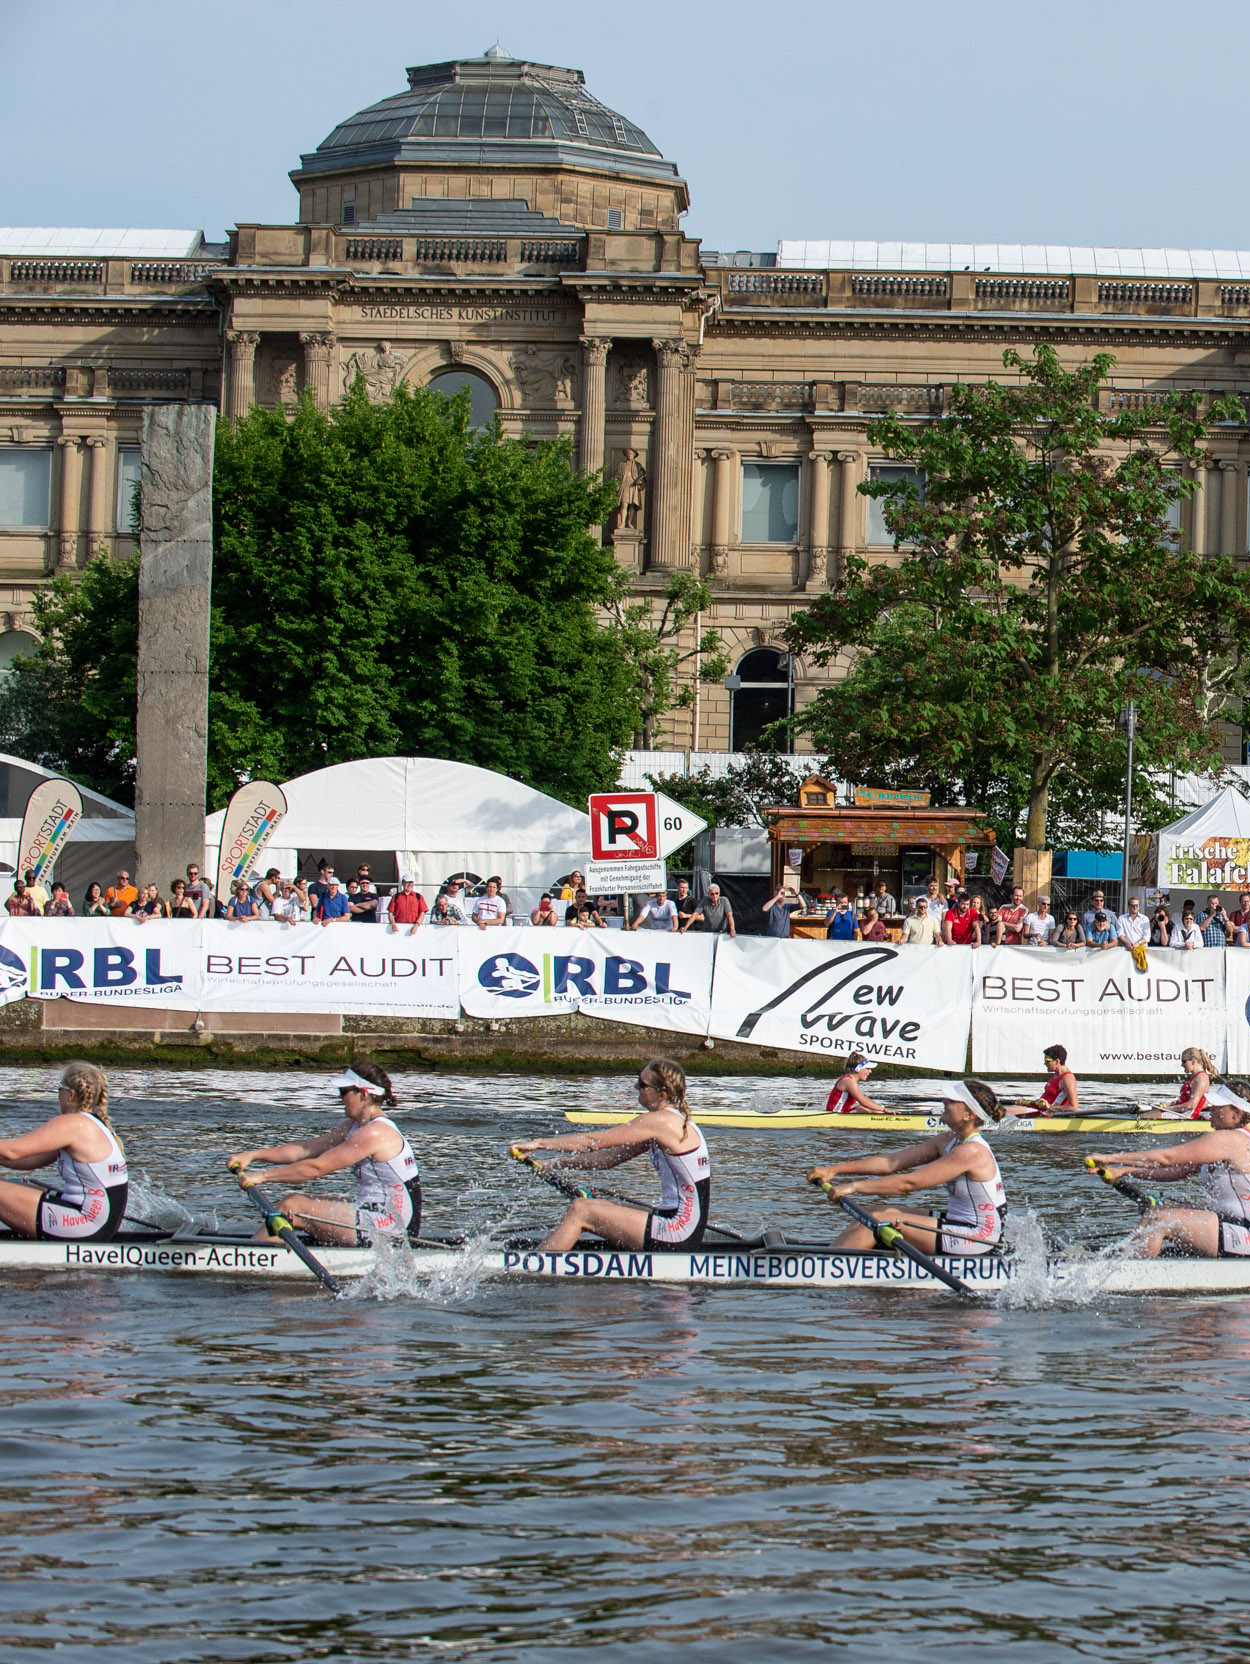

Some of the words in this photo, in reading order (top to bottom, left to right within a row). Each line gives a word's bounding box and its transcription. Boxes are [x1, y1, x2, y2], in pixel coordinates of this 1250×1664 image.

[361, 306, 453, 320] STAEDELSCHES
[21, 799, 69, 873] SPORTSTADT
[221, 799, 272, 875] SPORTSTADT
[663, 817, 682, 831] 60
[37, 838, 63, 883] FRANKFURT
[1170, 841, 1238, 860] frische
[589, 866, 623, 875] Ausgenommen
[624, 864, 661, 873] Fahrgastschiffe
[609, 874, 642, 882] Genehmigung
[41, 946, 183, 990] RBL
[207, 955, 315, 976] BEST
[329, 956, 453, 977] AUDIT
[554, 956, 691, 999] RBL
[982, 976, 1084, 1002] BEST
[1098, 977, 1214, 1002] AUDIT
[799, 1033, 917, 1060] SPORTSWEAR
[66, 1245, 278, 1268] HavelQueen-Achter
[503, 1252, 653, 1278] POTSDAM
